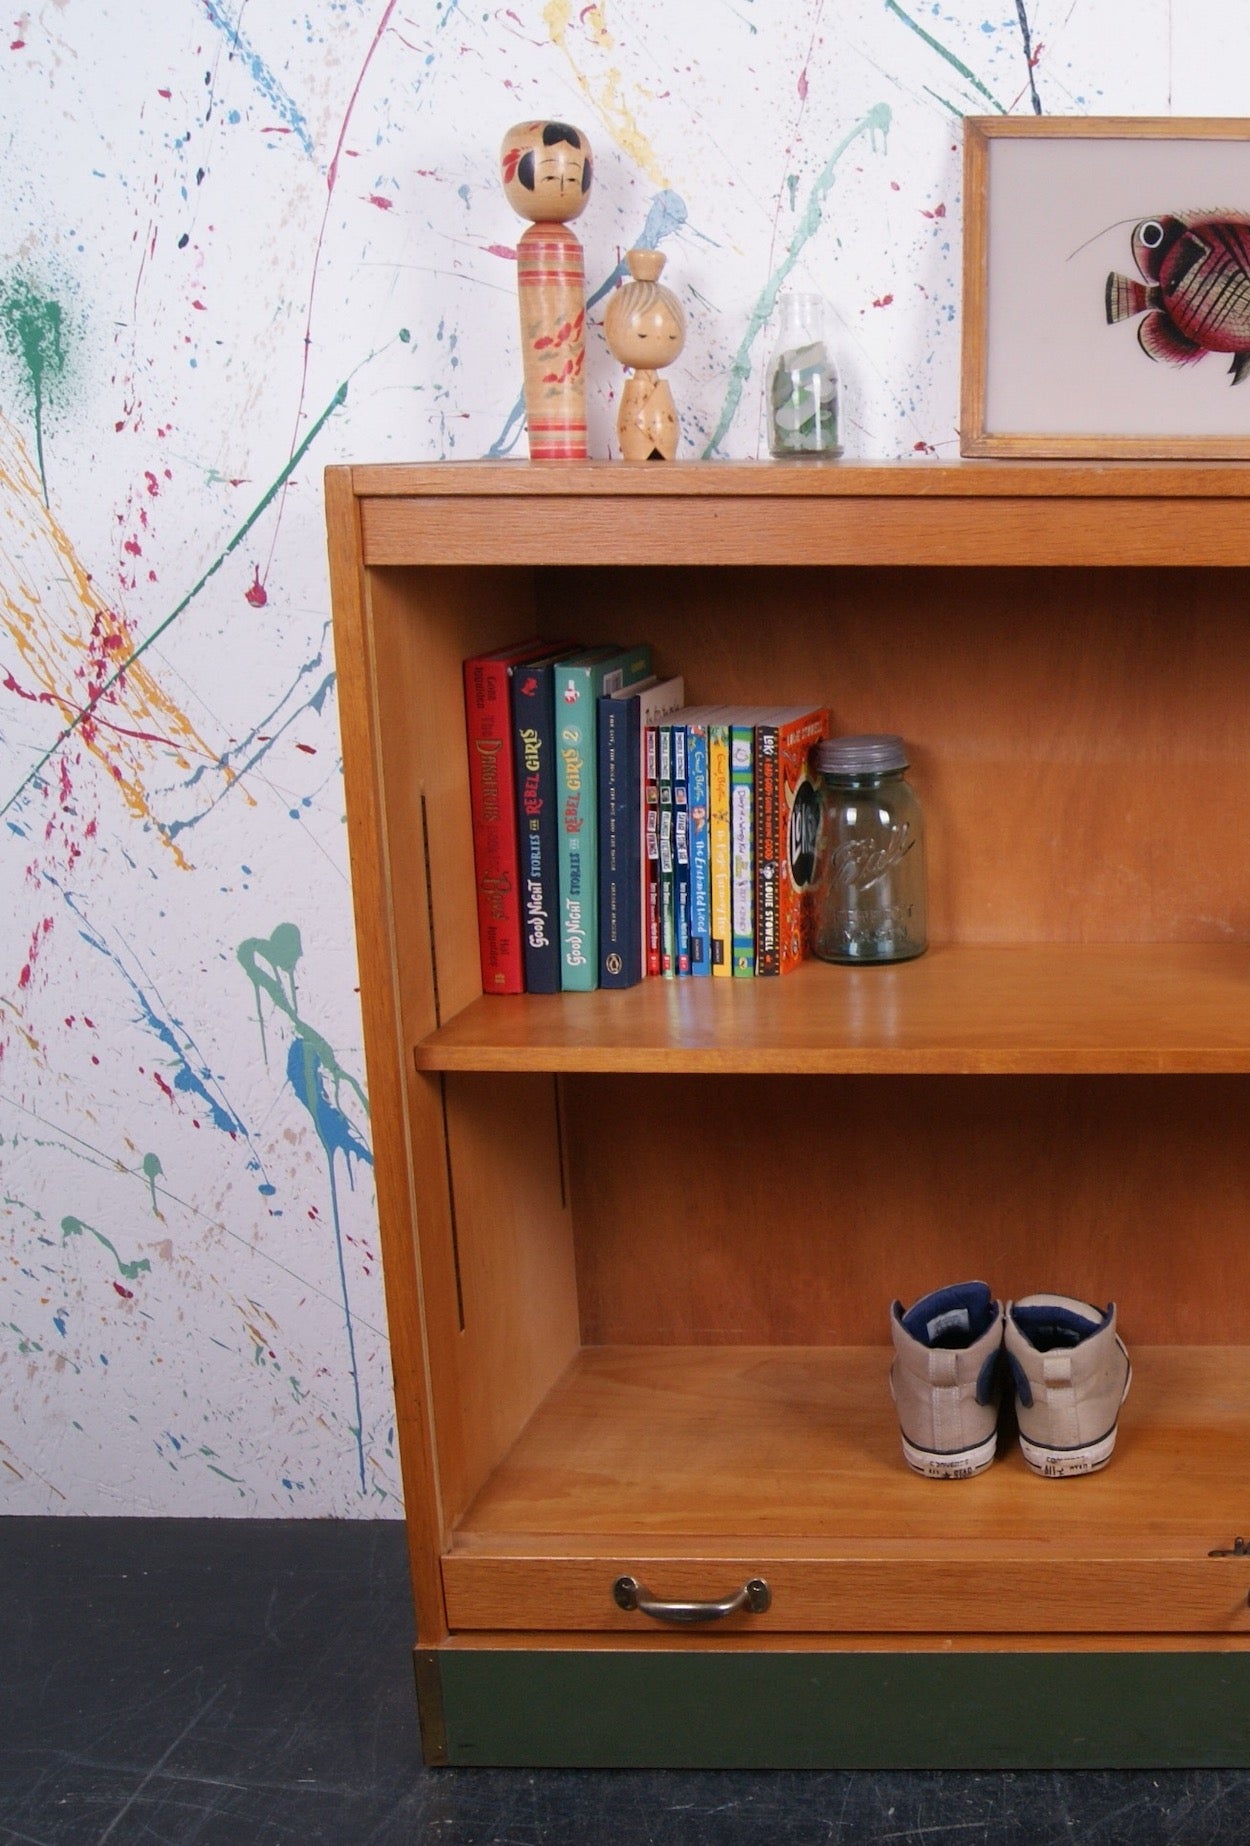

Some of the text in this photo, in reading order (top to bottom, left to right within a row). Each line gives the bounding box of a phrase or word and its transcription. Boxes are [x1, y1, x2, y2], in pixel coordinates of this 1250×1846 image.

[523, 773, 543, 815] REBEL
[563, 792, 584, 834] REBEL
[738, 790, 746, 808] Diary
[737, 821, 746, 842] Wimpy
[765, 839, 773, 860] GOOD
[529, 834, 541, 878] STORIES
[569, 852, 581, 896] STORIES
[695, 856, 706, 906] Enchanted
[765, 881, 773, 908] LOUIE
[697, 908, 707, 933] Wood
[765, 910, 774, 951] STOWELL
